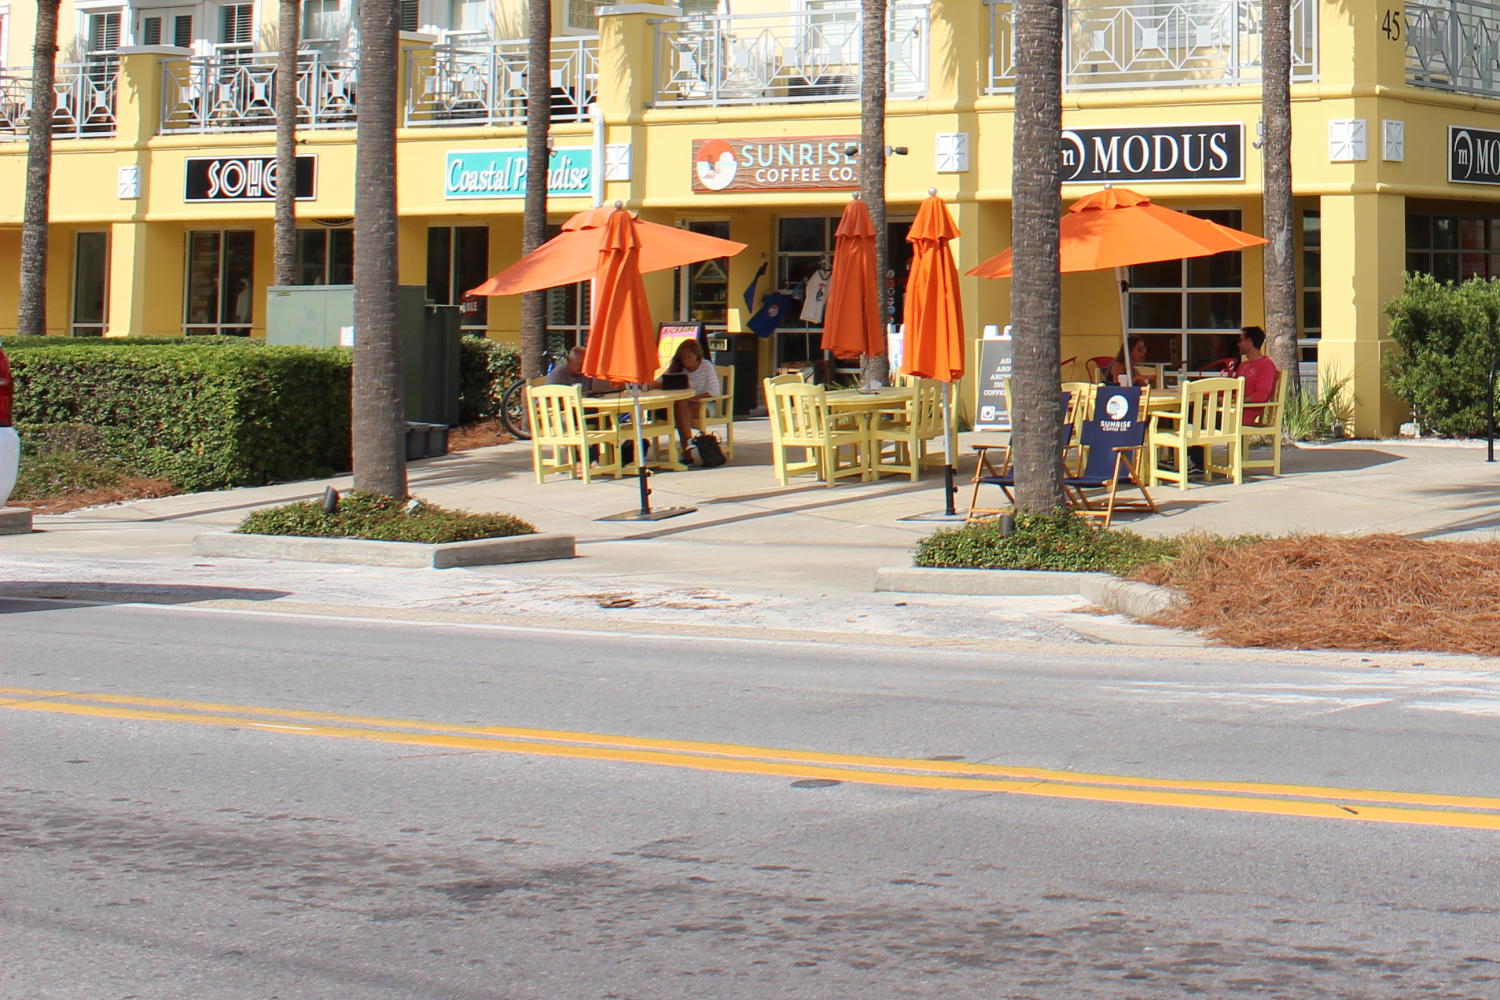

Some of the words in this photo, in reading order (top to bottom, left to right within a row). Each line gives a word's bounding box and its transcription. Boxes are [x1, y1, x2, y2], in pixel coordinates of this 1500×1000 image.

[1382, 9, 1400, 41] 45
[741, 142, 857, 167] SUNRISE
[1092, 132, 1228, 174] MODUS
[448, 157, 512, 192] Coastal
[514, 155, 589, 192] Pdise
[755, 168, 820, 182] COFFEE
[829, 167, 857, 181] CO.
[1100, 420, 1131, 428] SUNRISE
